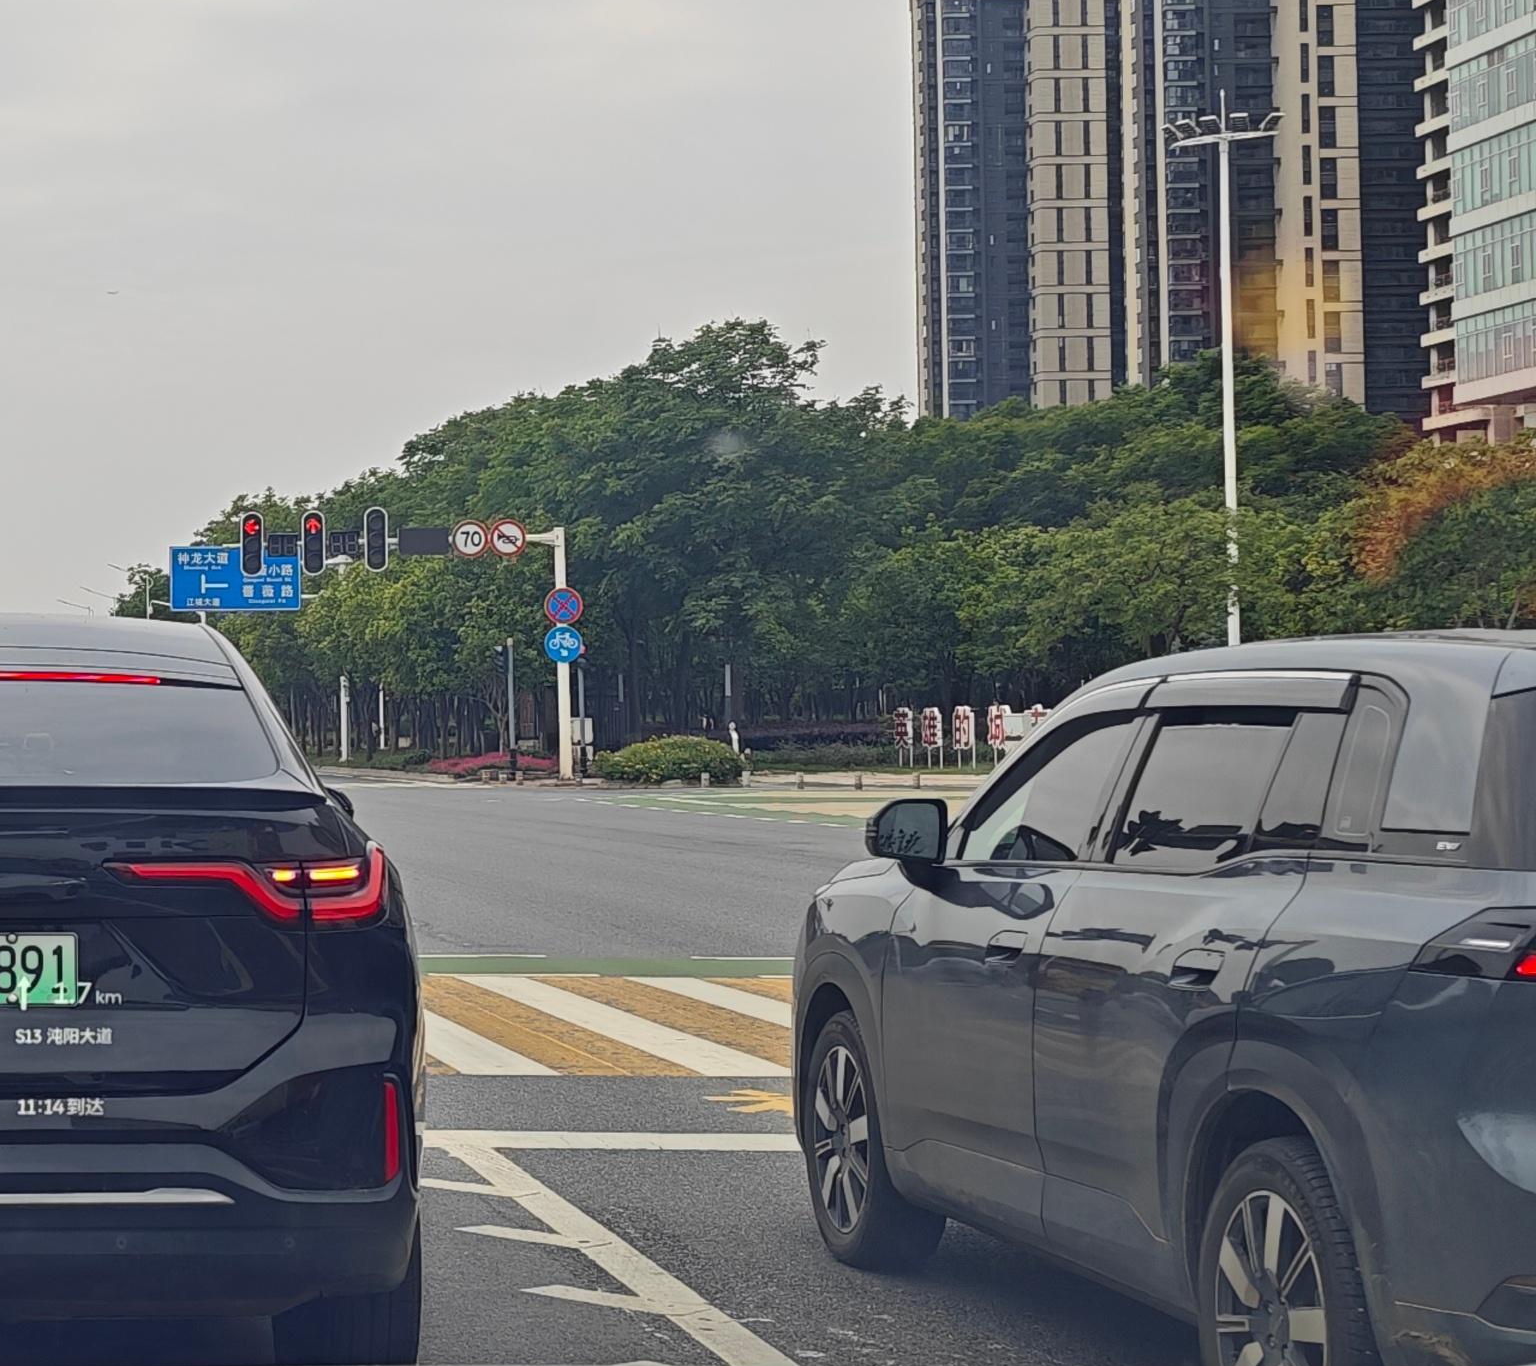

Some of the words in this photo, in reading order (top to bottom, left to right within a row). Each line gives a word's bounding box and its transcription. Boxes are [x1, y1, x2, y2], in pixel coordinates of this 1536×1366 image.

[460, 530, 482, 548] 70
[177, 552, 229, 565] 神龙大道
[53, 981, 93, 1005] 1.7
[95, 989, 123, 1005] km
[15, 1028, 42, 1044] S13
[46, 1026, 113, 1045] 沌阳大道
